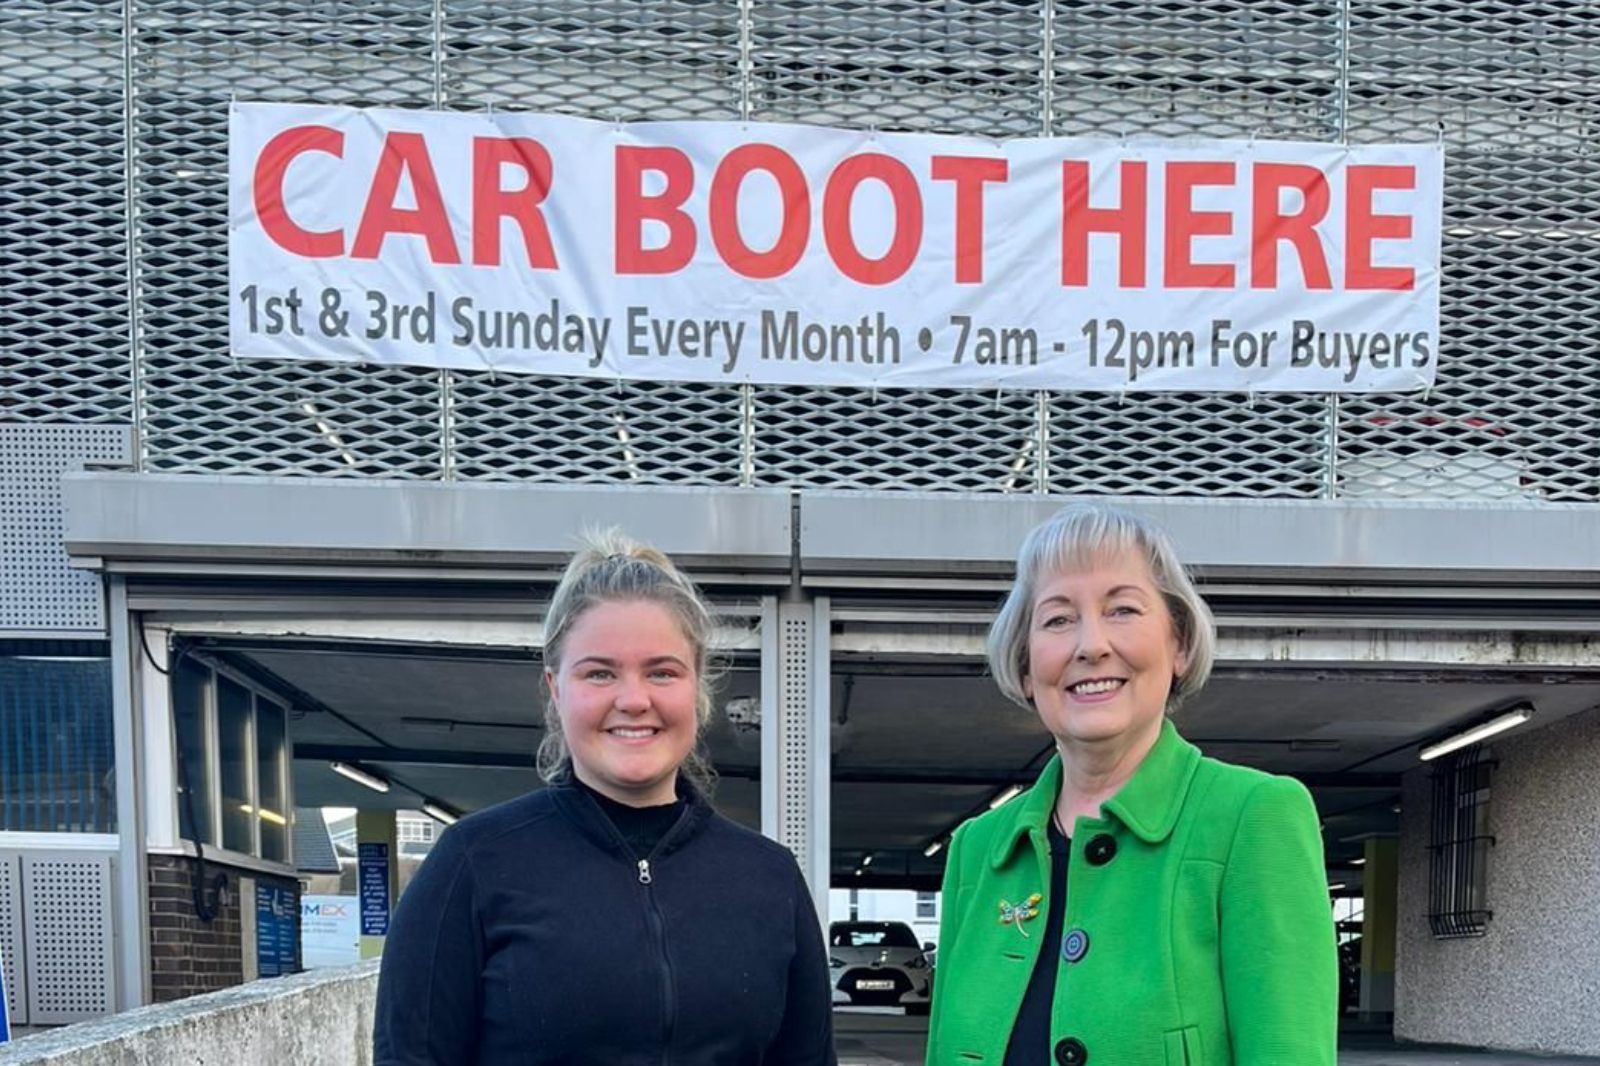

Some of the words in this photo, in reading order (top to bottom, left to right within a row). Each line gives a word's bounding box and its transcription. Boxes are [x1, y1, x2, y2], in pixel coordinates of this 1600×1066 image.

[253, 123, 558, 270] CAR
[614, 142, 1009, 286] BOOT
[1061, 160, 1416, 291] HERE
[238, 284, 305, 337] 1st
[318, 286, 350, 338] &
[365, 290, 436, 344] 3rd
[451, 296, 612, 369] Sunday
[626, 306, 746, 374] Every
[760, 308, 901, 365] Month
[949, 315, 1038, 366] 7am
[1081, 318, 1195, 382] 12pm
[1210, 319, 1278, 369] For
[1290, 319, 1430, 384] Buyers
